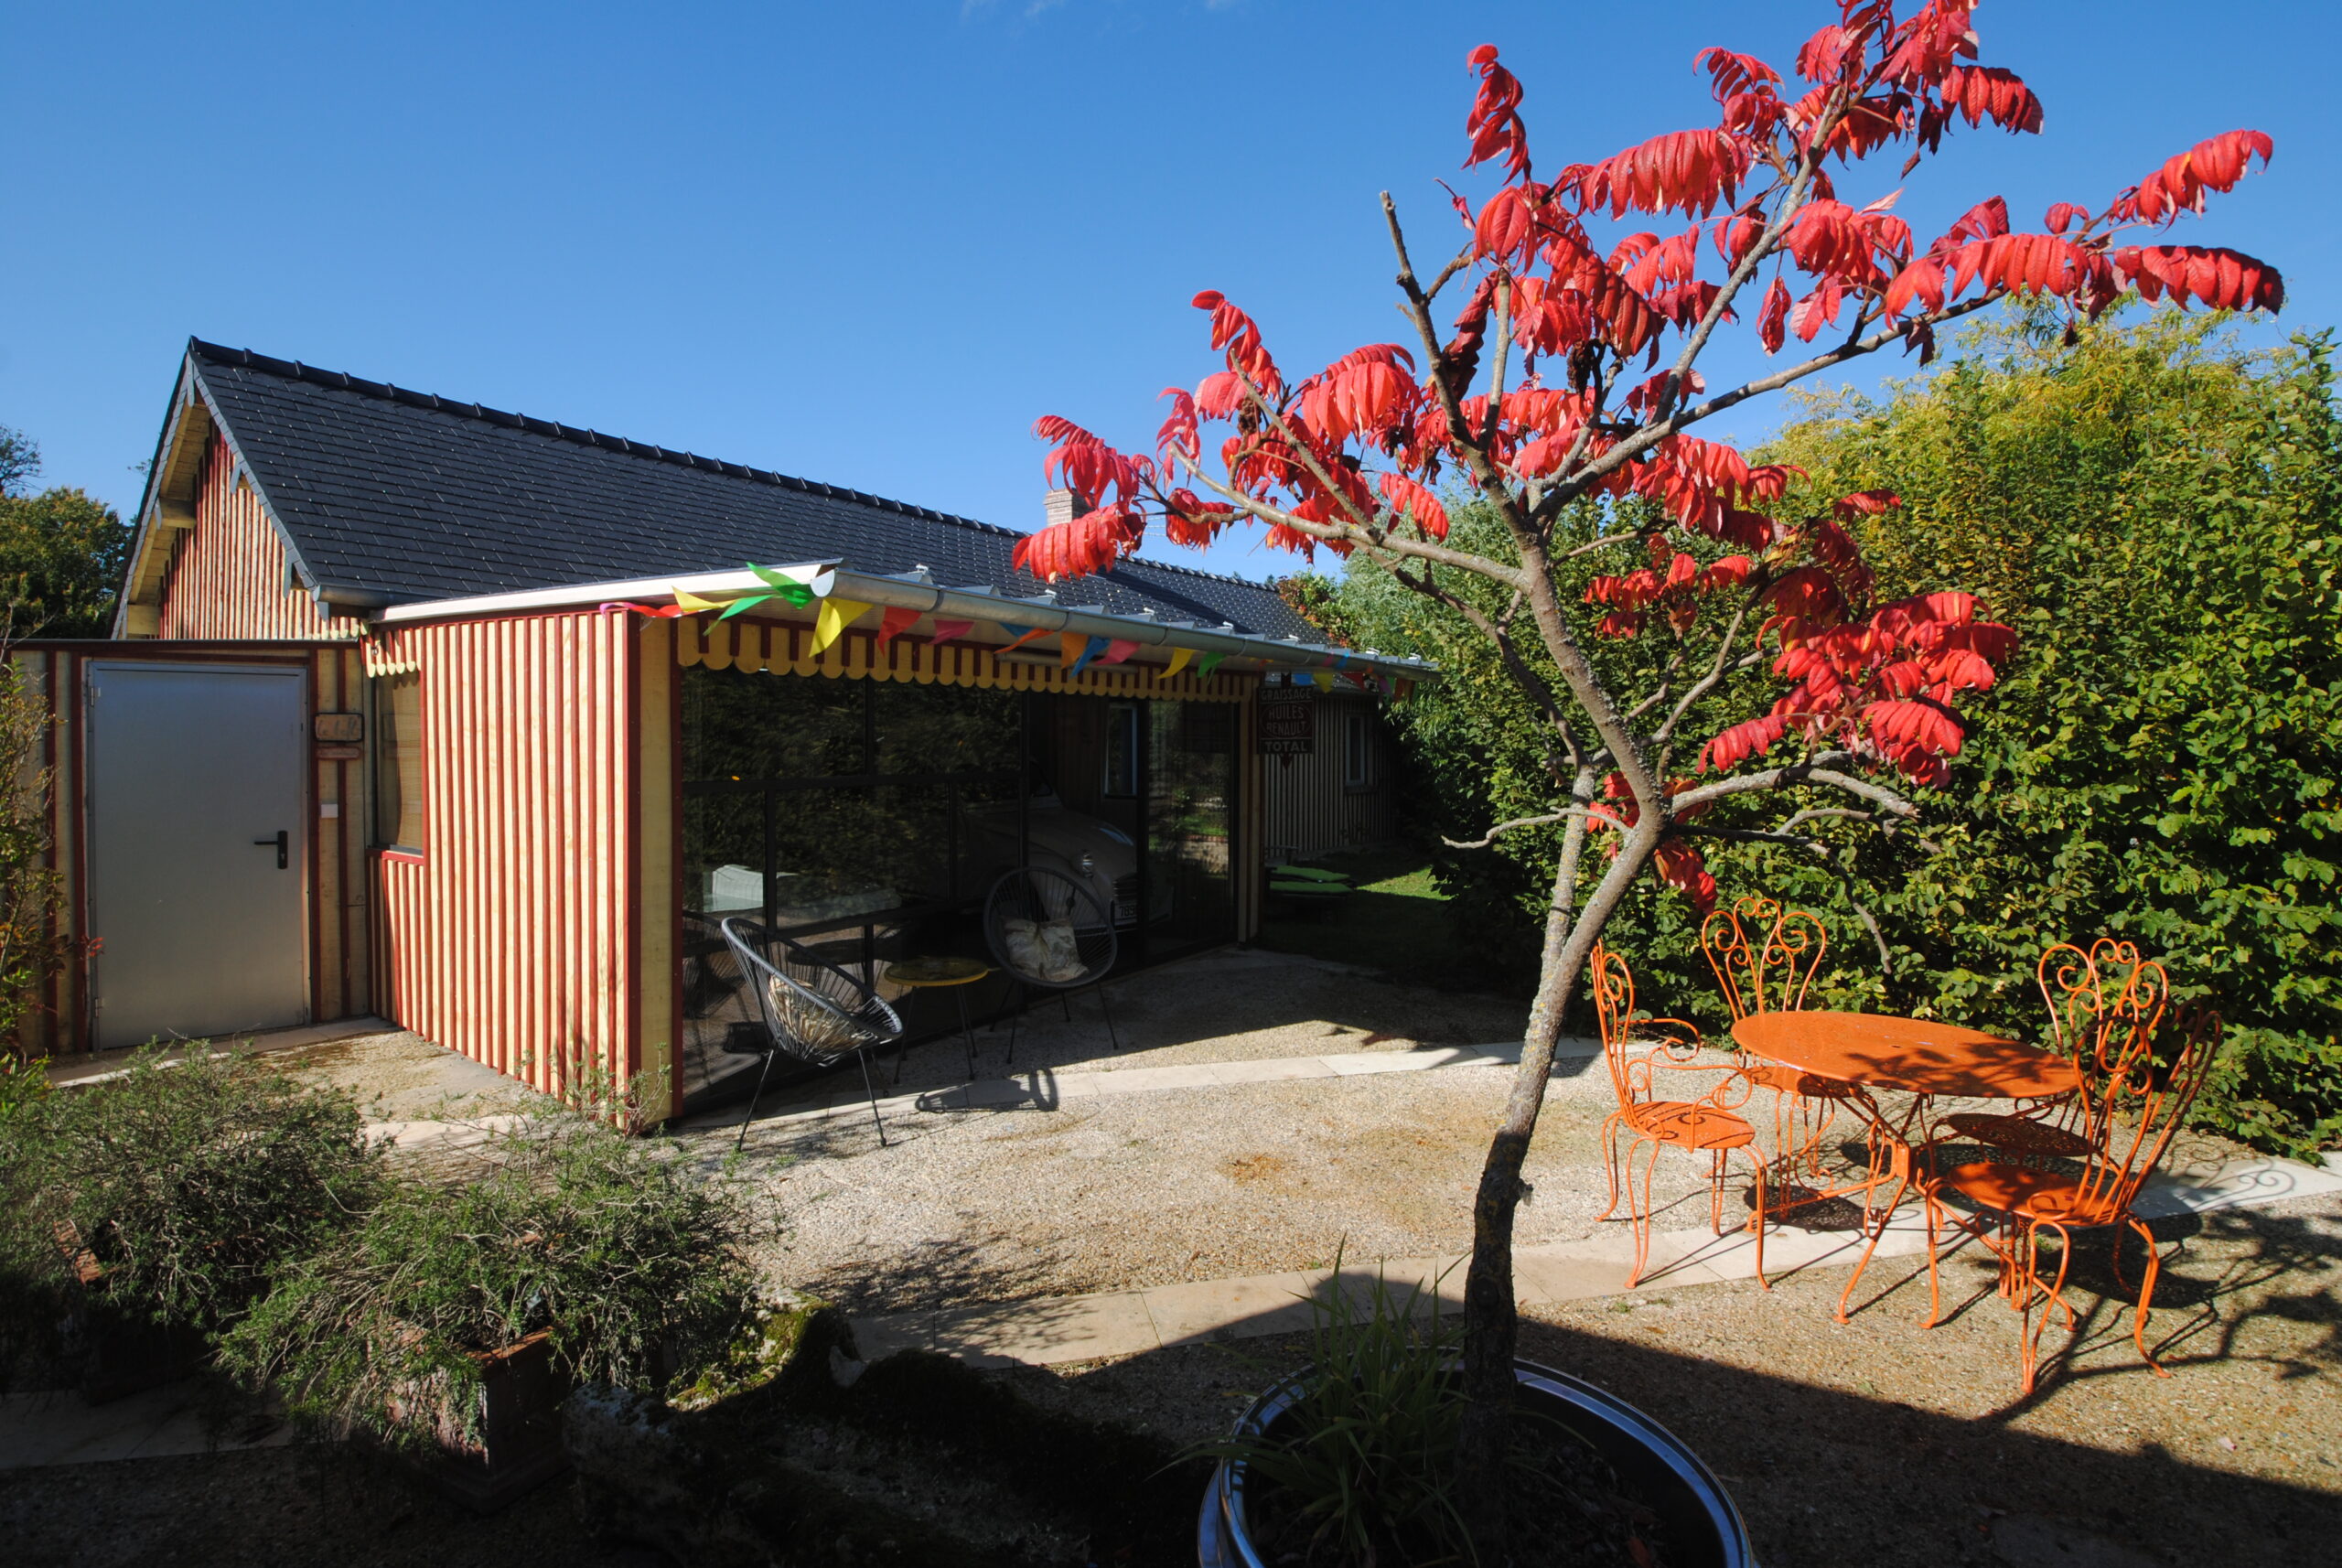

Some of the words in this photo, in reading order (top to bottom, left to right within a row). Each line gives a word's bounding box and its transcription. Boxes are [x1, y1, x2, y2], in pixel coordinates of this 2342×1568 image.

[1261, 687, 1312, 702] GRAISSAGE
[1268, 703, 1305, 721] HUILES
[1266, 720, 1307, 736] RENAULT
[1264, 740, 1308, 753] TOTAL
